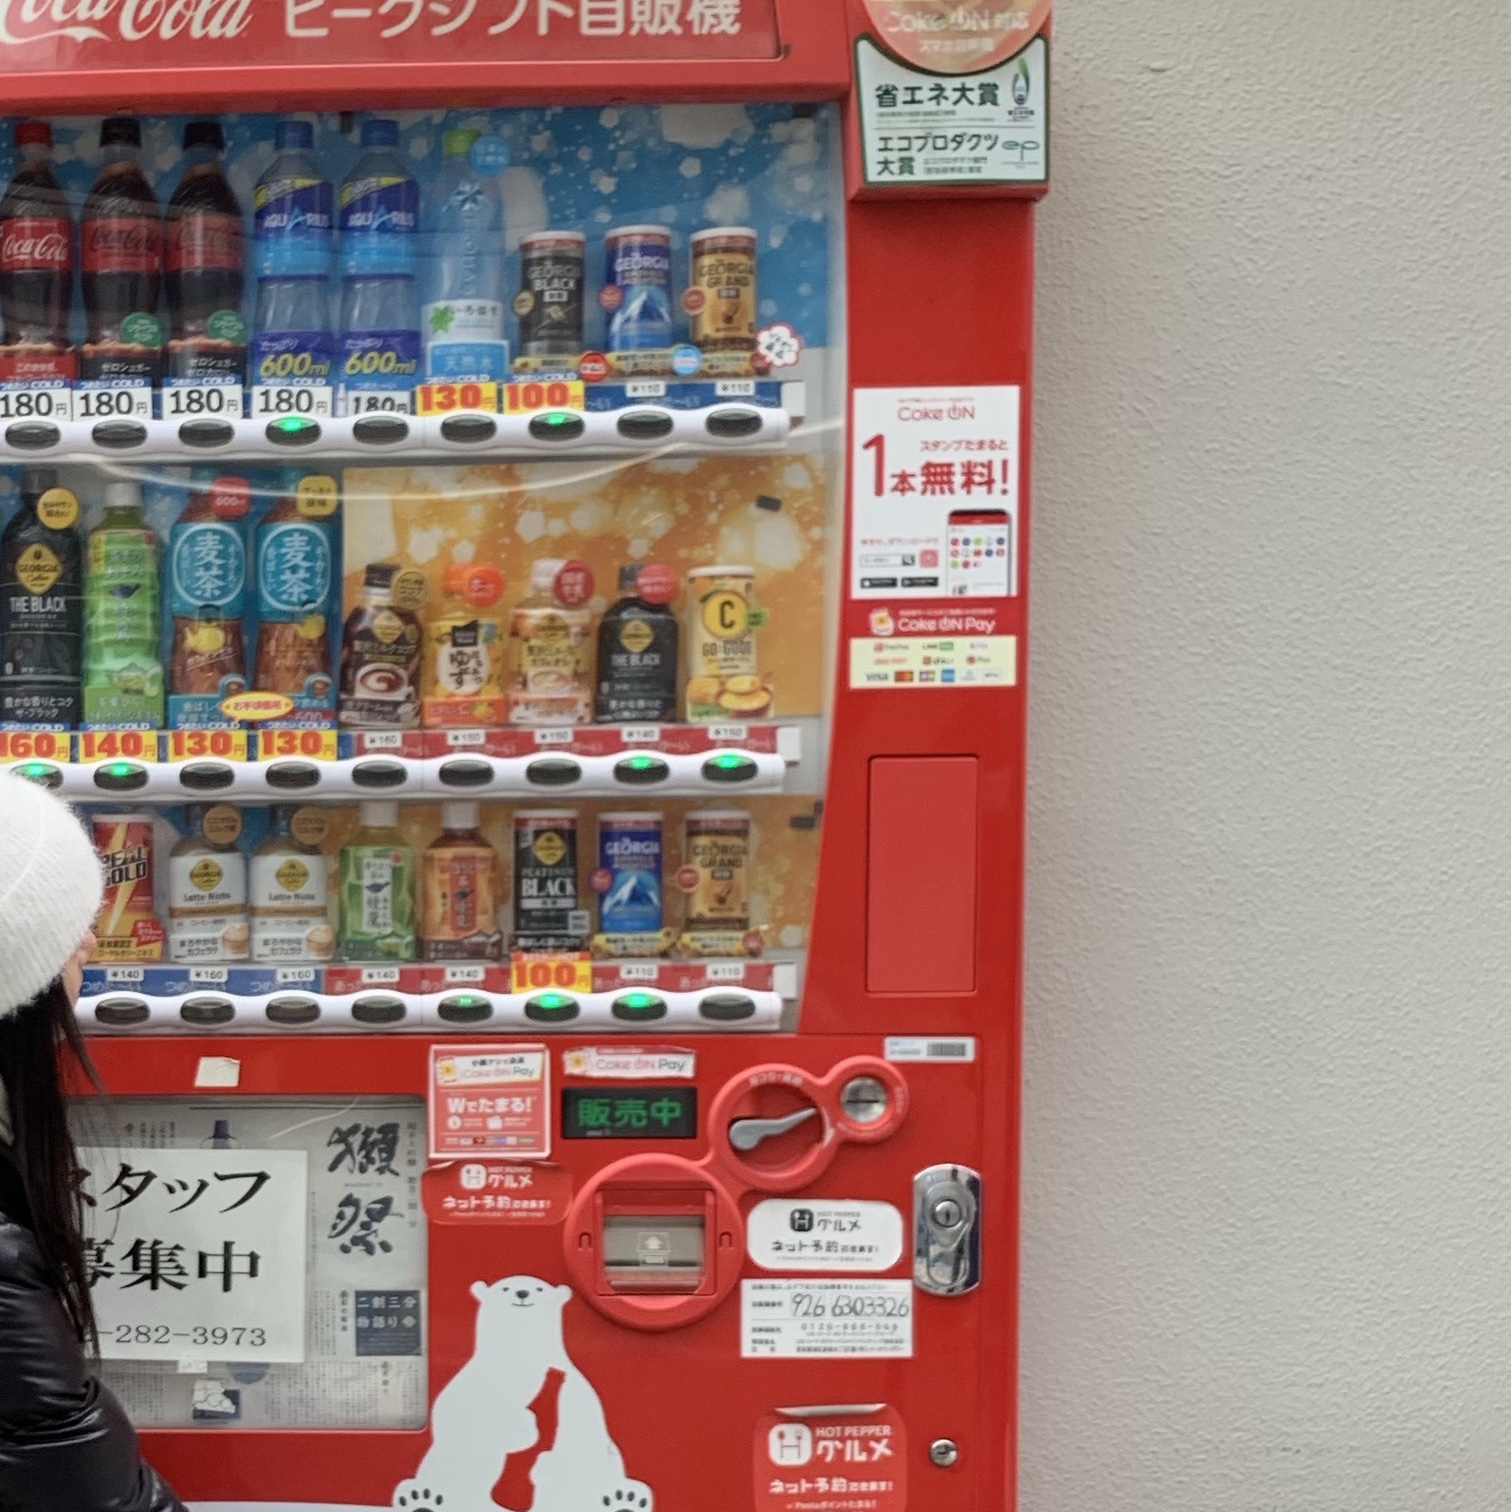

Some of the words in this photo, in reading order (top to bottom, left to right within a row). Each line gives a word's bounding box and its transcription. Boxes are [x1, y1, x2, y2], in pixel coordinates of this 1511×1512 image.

[875, 82, 1001, 108] 省エネ大賞
[877, 132, 1000, 154] エコプロダクツ
[876, 156, 916, 177] 大賞
[534, 278, 576, 291] BLACK
[259, 352, 330, 376] 600ml
[344, 351, 416, 376] 600ml
[0, 392, 68, 417] 180円
[80, 391, 149, 416] 180円
[170, 388, 238, 414] 180円
[258, 389, 329, 414] 180円
[898, 406, 943, 422] Coke
[948, 402, 976, 421] ON
[862, 433, 1010, 498] 1本無料!
[193, 532, 227, 598] 麦茶
[279, 532, 314, 600] 麦茶
[10, 597, 30, 613] THE
[32, 596, 67, 613] BLACK
[719, 600, 736, 630] C
[898, 617, 938, 632] Coke
[965, 617, 996, 634] Pay
[631, 653, 661, 666] BLACK
[82, 731, 156, 757] 140円
[171, 730, 246, 756] 130円
[262, 730, 336, 756] 130円
[521, 878, 576, 898] BLACK
[657, 1056, 687, 1073] Pay
[577, 1097, 683, 1128] 販売中
[488, 1174, 534, 1189] グルメ
[817, 1219, 862, 1232] グルメ
[791, 1292, 826, 1319] 926
[830, 1293, 910, 1319] 6303326
[816, 1425, 842, 1437] HOT
[844, 1424, 892, 1437] PEPPER
[816, 1438, 893, 1463] グルメ
